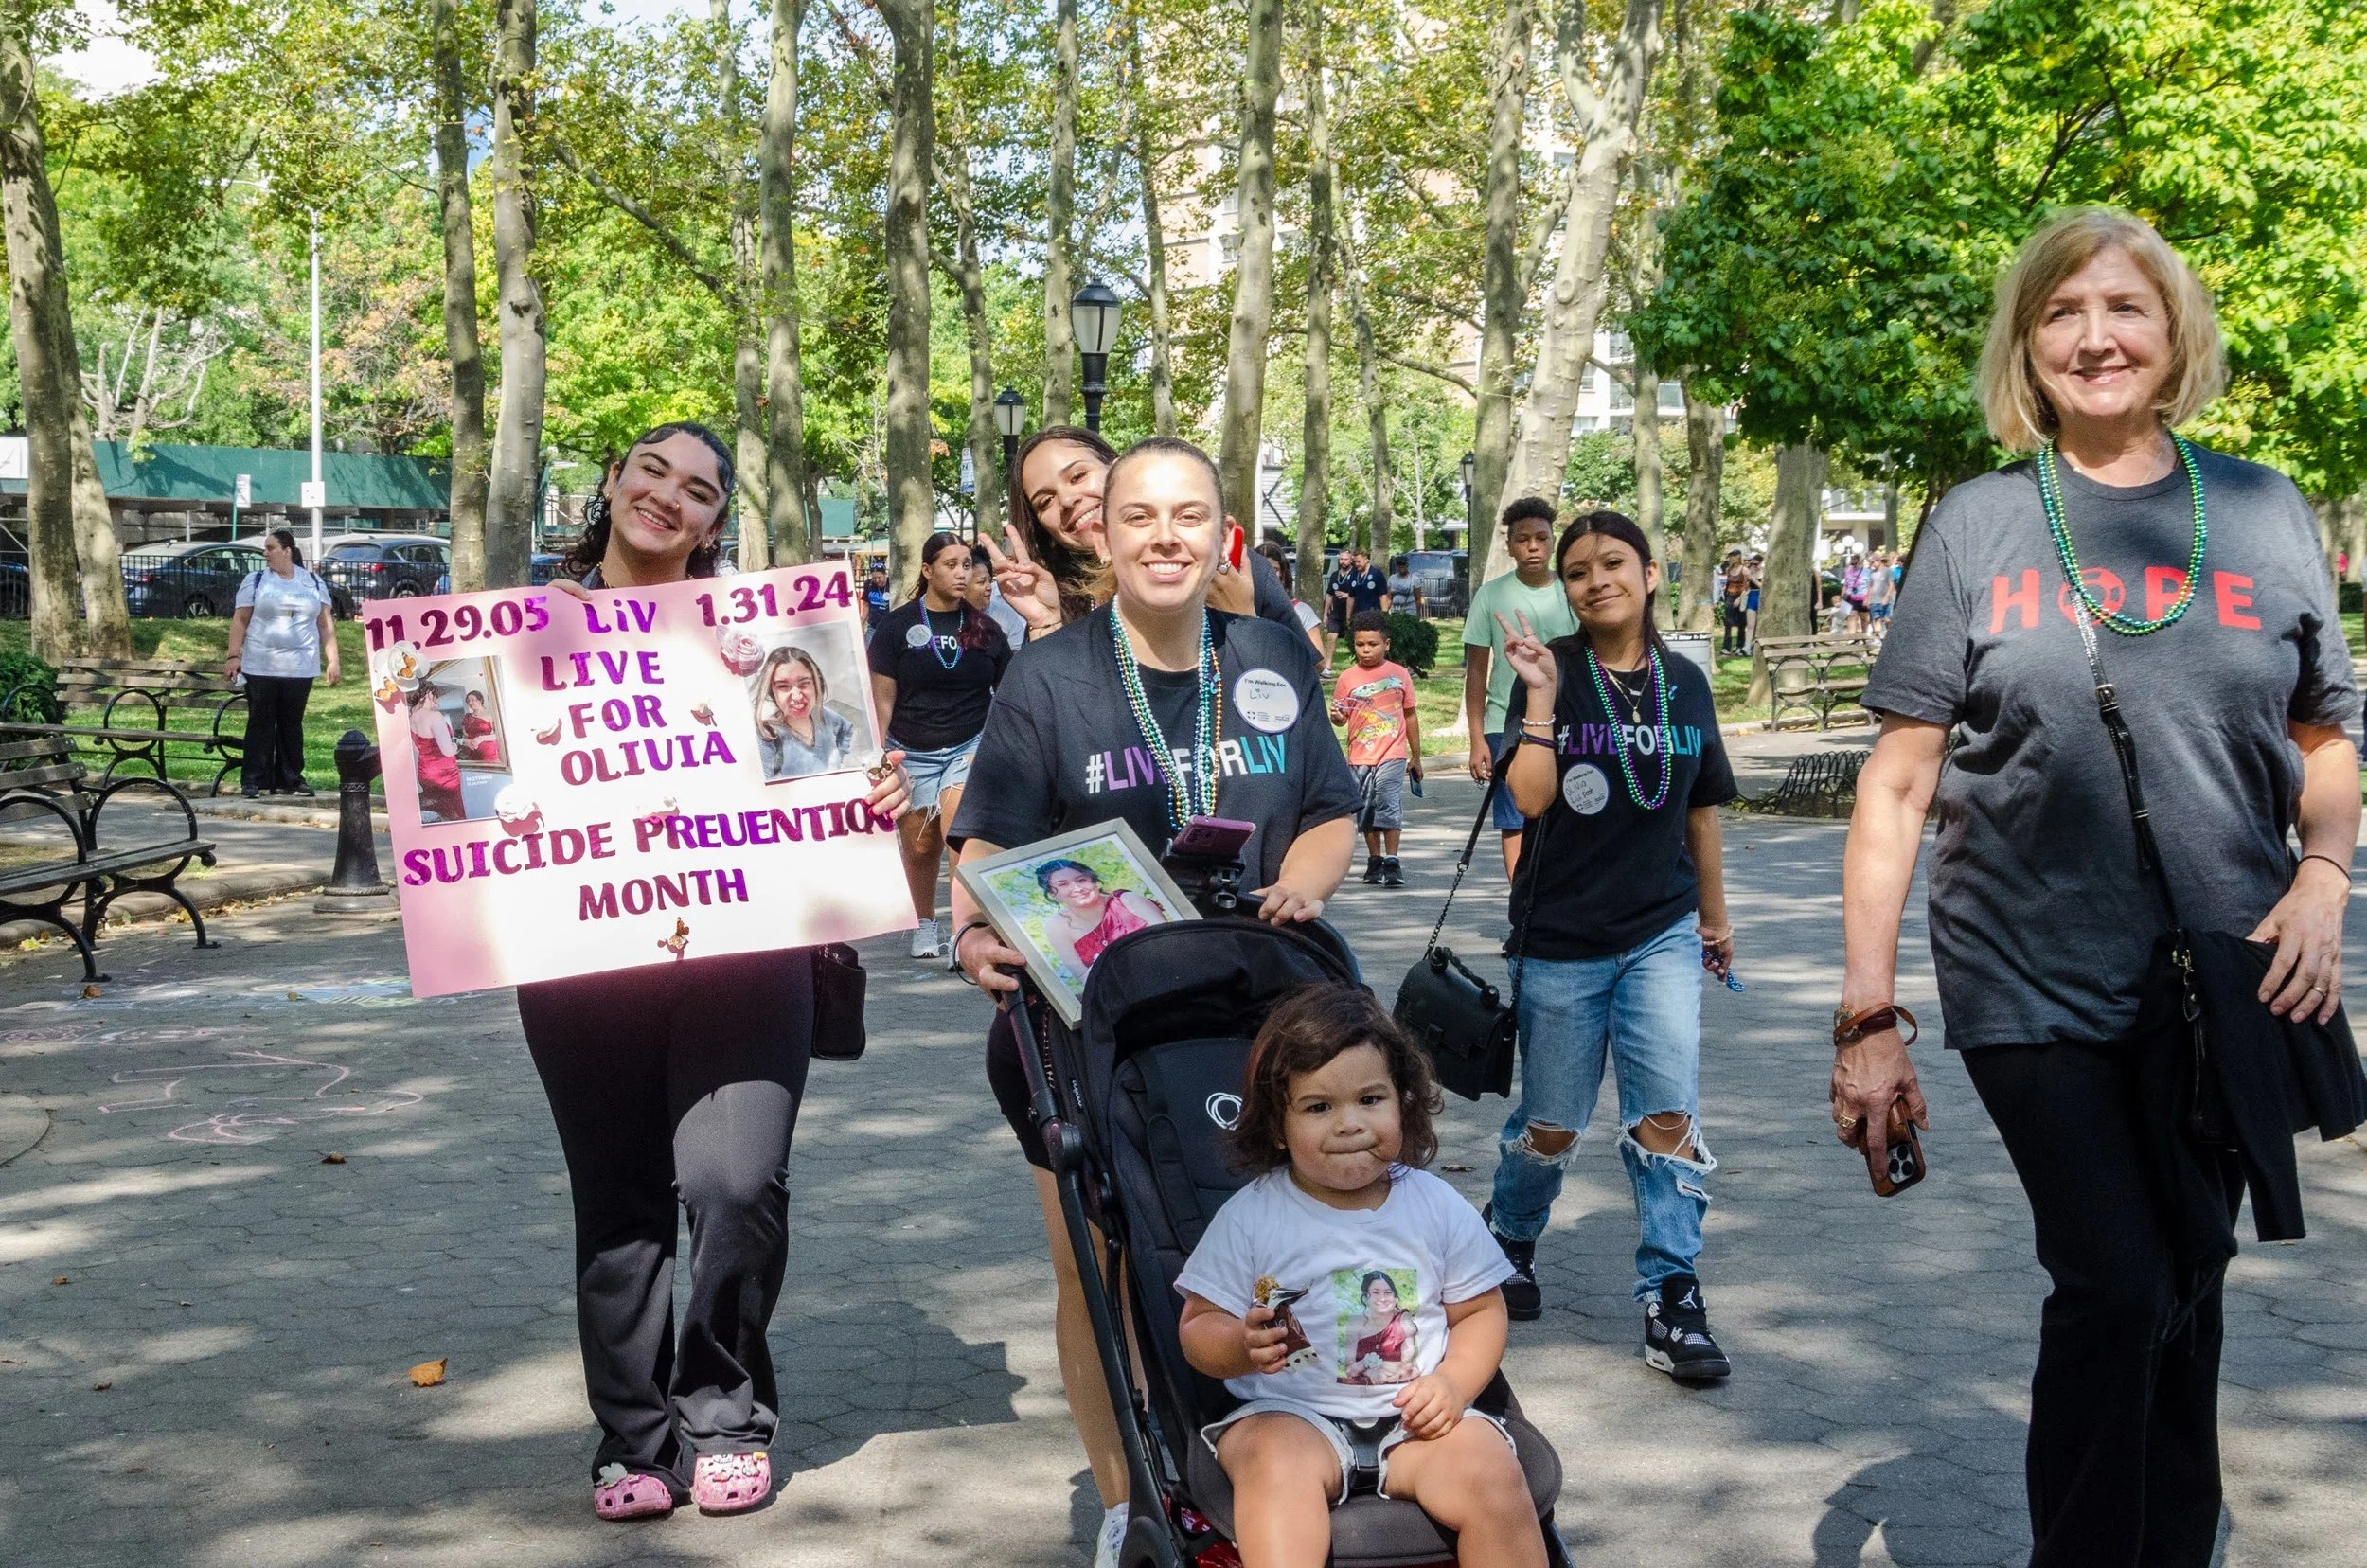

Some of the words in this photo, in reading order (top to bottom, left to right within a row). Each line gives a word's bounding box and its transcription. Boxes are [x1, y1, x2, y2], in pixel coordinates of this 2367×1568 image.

[365, 596, 549, 652] 11.29.05
[695, 571, 854, 627] 1.31.24
[1989, 566, 2262, 635] HOPE
[540, 650, 665, 691] LIVE
[568, 695, 667, 739] FOR
[1085, 734, 1287, 794] #LIVFORLIV
[403, 822, 616, 886] SUICIDE
[578, 868, 750, 921] MONTH
